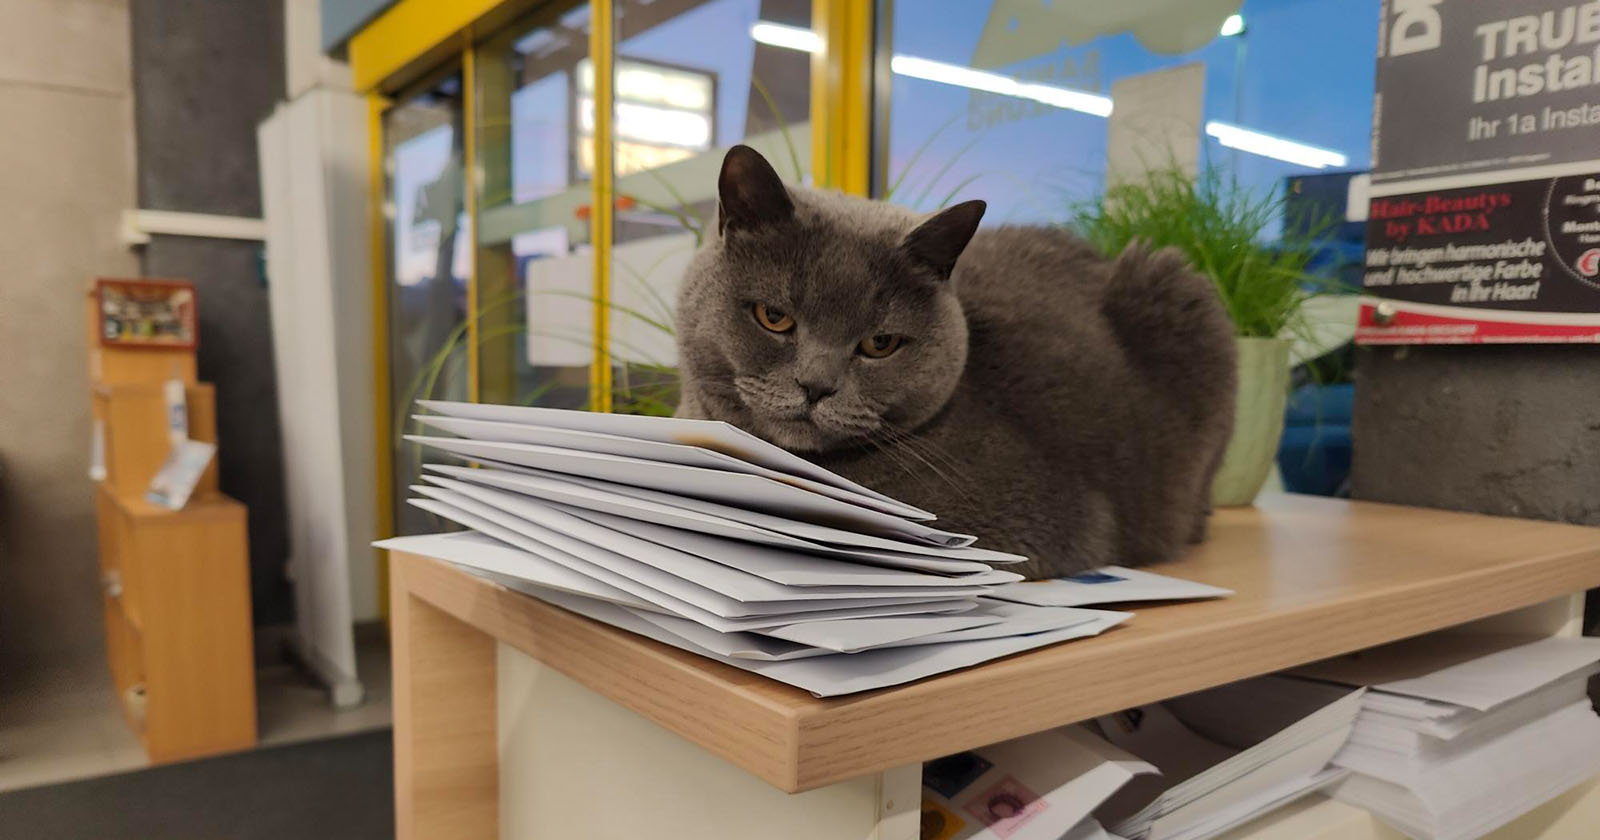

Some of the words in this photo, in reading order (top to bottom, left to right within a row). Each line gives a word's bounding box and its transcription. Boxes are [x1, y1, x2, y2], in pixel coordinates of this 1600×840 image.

[1468, 116, 1500, 141] Ihr
[1506, 113, 1537, 136] 1a
[1370, 191, 1511, 220] Hair-Beautys
[1386, 221, 1408, 243] by
[1417, 212, 1490, 235] KADA
[1365, 247, 1389, 268] Wir
[1390, 246, 1444, 270] bringen
[1444, 237, 1547, 263] harmonische
[1363, 266, 1395, 288] und
[1396, 262, 1494, 286] hochwertige
[1494, 258, 1543, 281] Farbe
[1450, 282, 1469, 303] in
[1492, 280, 1540, 301] Haar!
